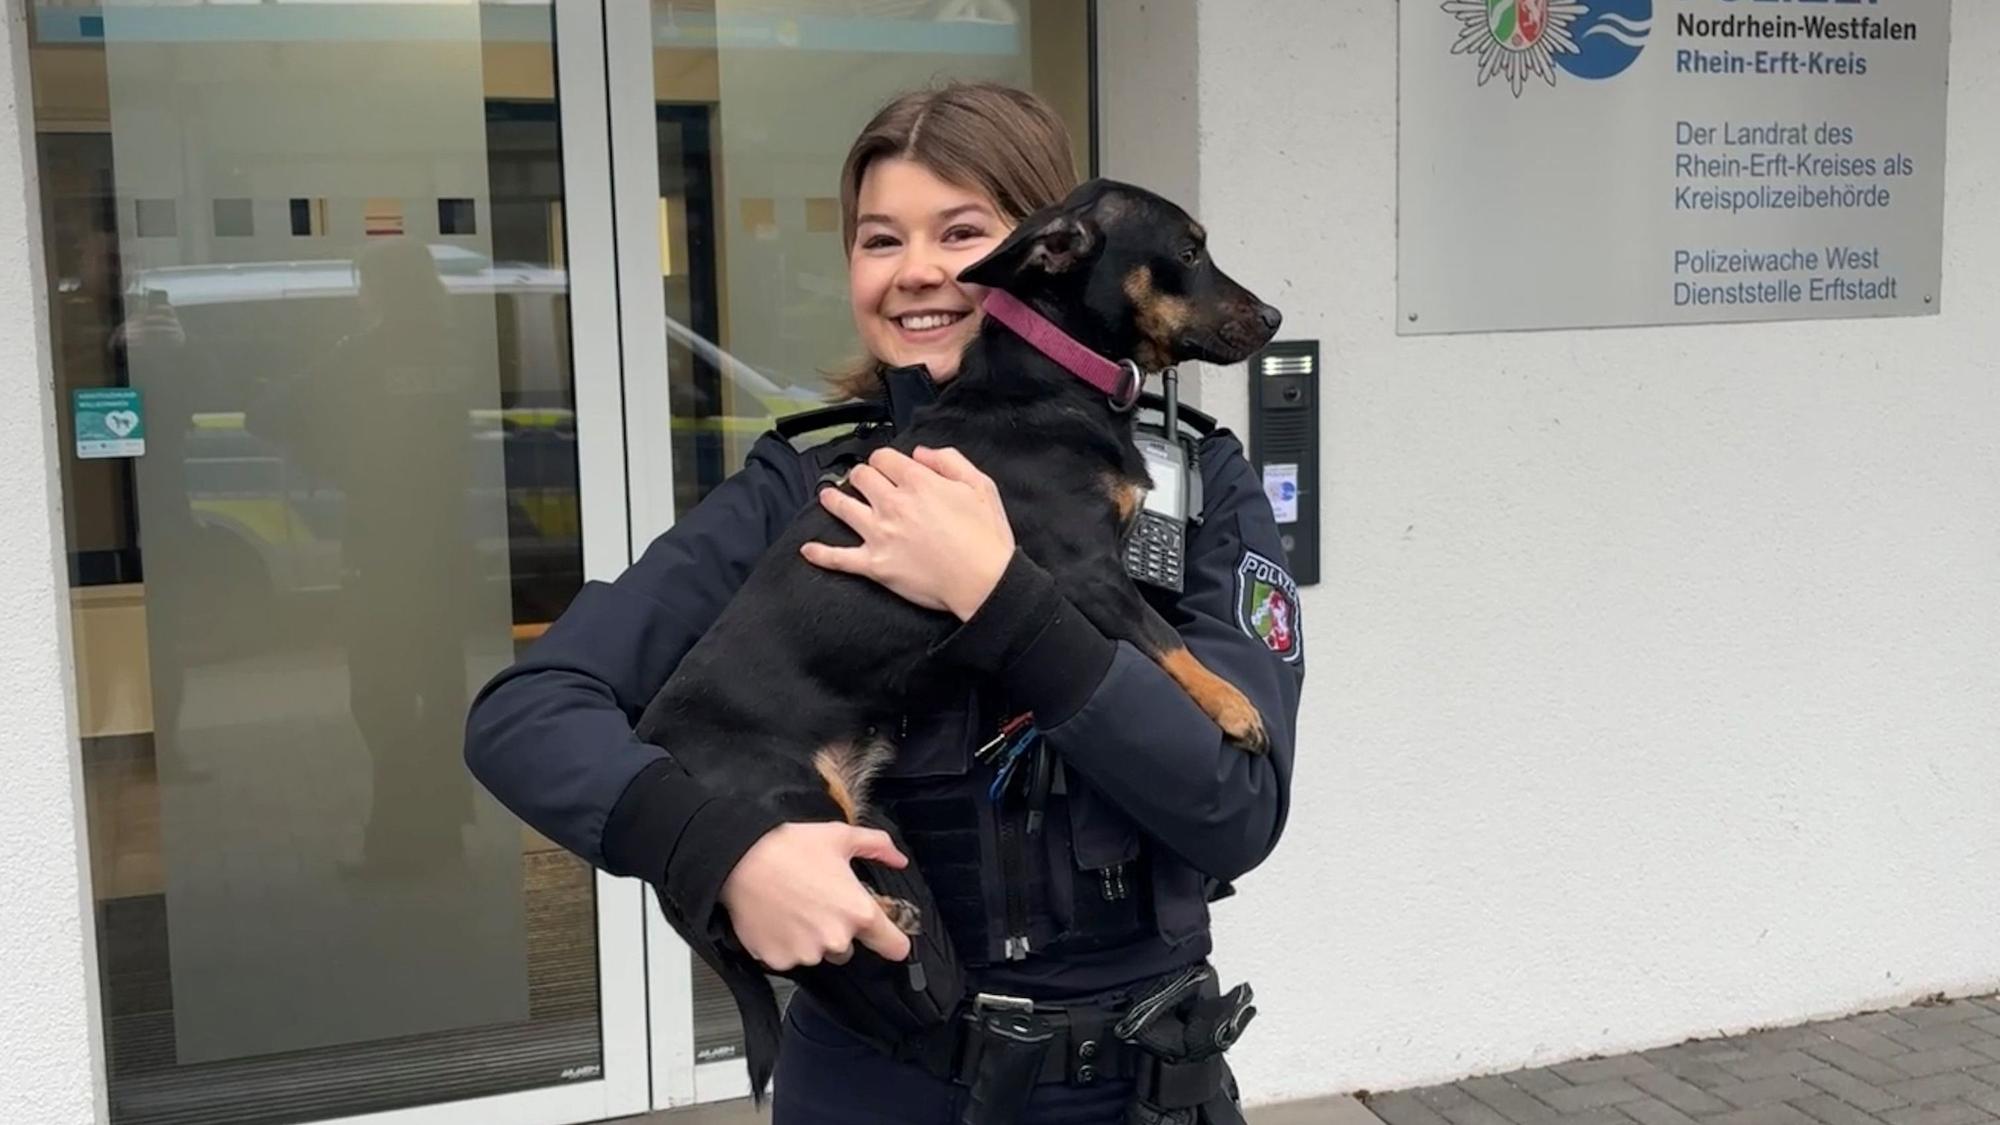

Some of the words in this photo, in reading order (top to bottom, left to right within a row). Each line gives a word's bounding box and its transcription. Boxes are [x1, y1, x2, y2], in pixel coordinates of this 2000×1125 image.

[1677, 13, 1917, 40] Nordrhein-Westfalen
[1677, 50, 1867, 74] Rhein-Erft-Kreis
[1676, 122, 1717, 145] Der
[1724, 122, 1807, 145] Landrat
[1814, 122, 1853, 145] des
[1676, 153, 1876, 177] Rhein-Erft-Kreises
[1883, 153, 1913, 176] als
[1675, 184, 1890, 213] Kreispolizeibehörde
[1674, 249, 1818, 274] Polizeiwache
[1825, 247, 1879, 270] West
[1673, 280, 1801, 306] Dienststelle
[1809, 276, 1897, 301] Erftstadt
